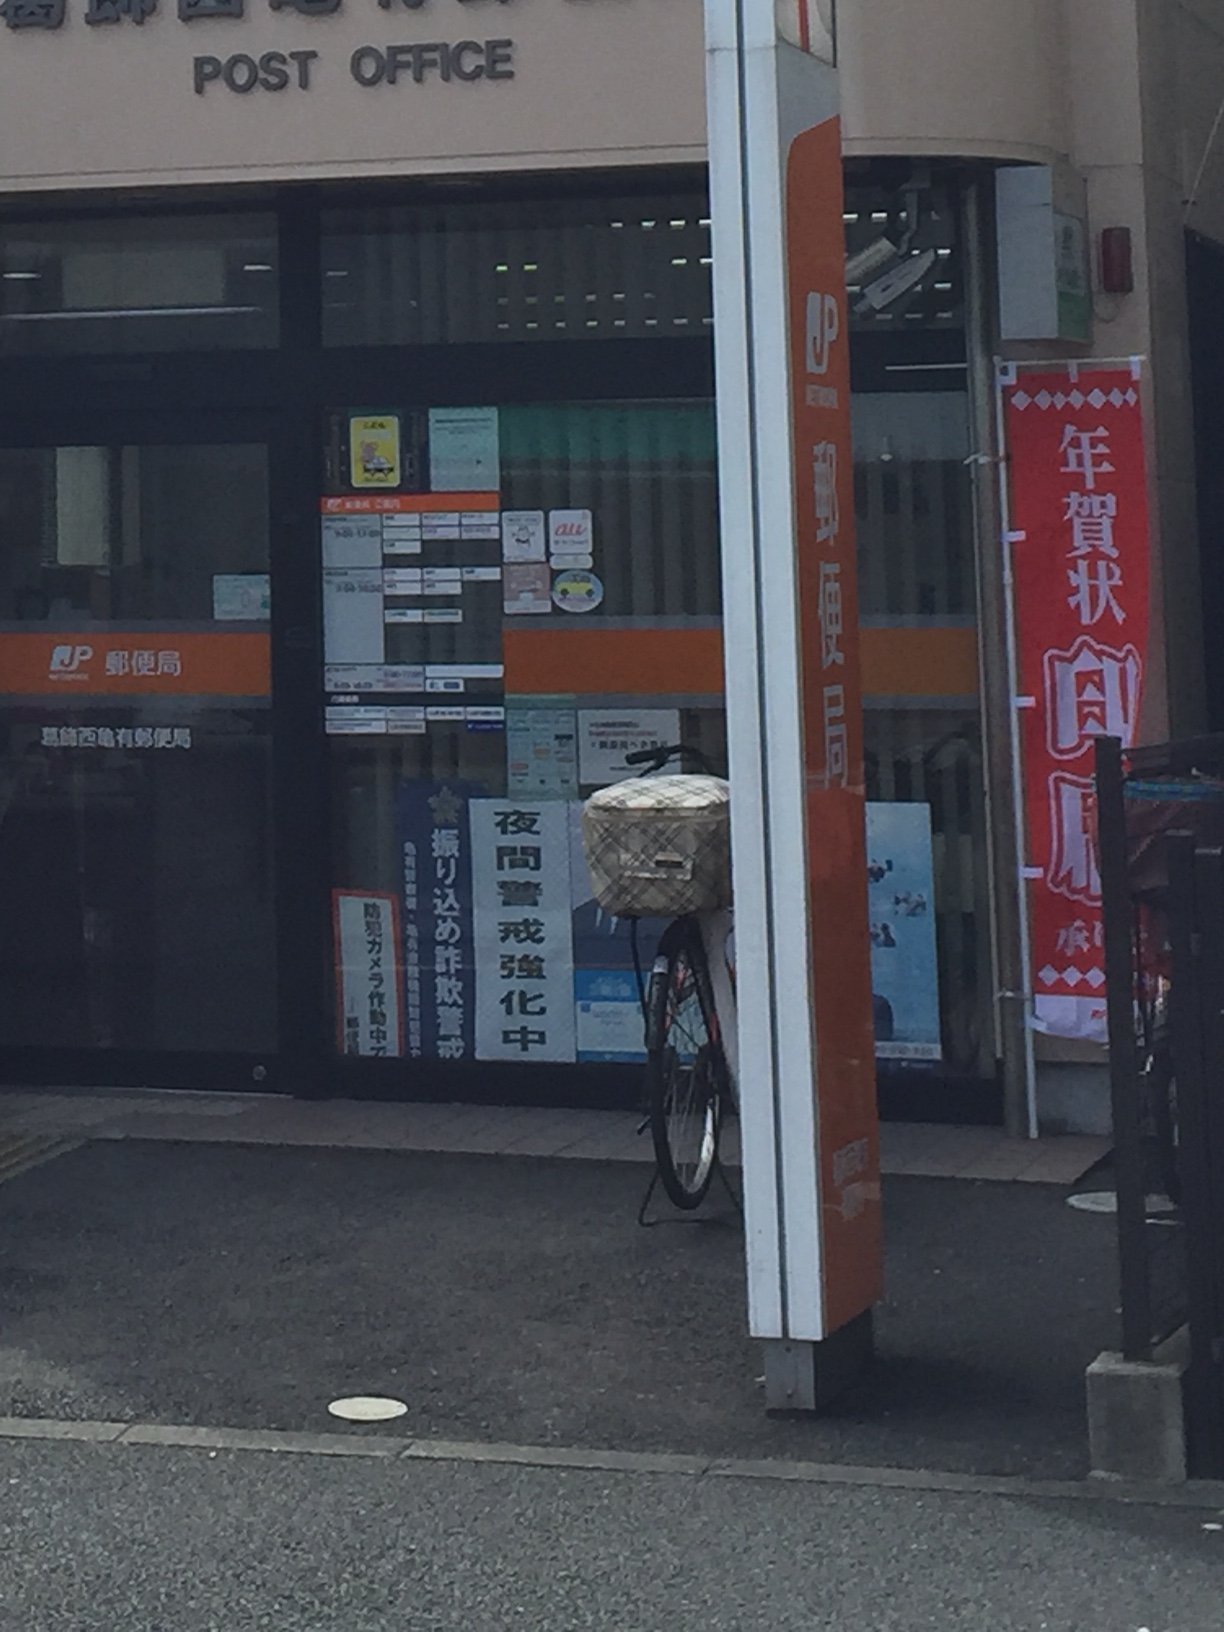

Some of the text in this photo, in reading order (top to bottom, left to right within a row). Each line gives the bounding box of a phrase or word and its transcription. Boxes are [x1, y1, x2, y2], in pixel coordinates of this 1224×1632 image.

[193, 39, 515, 95] POST OFFICE
[1058, 424, 1127, 626] 年賀状
[105, 649, 182, 677] 郵便局
[493, 809, 547, 1052] 夜間警戒強化中
